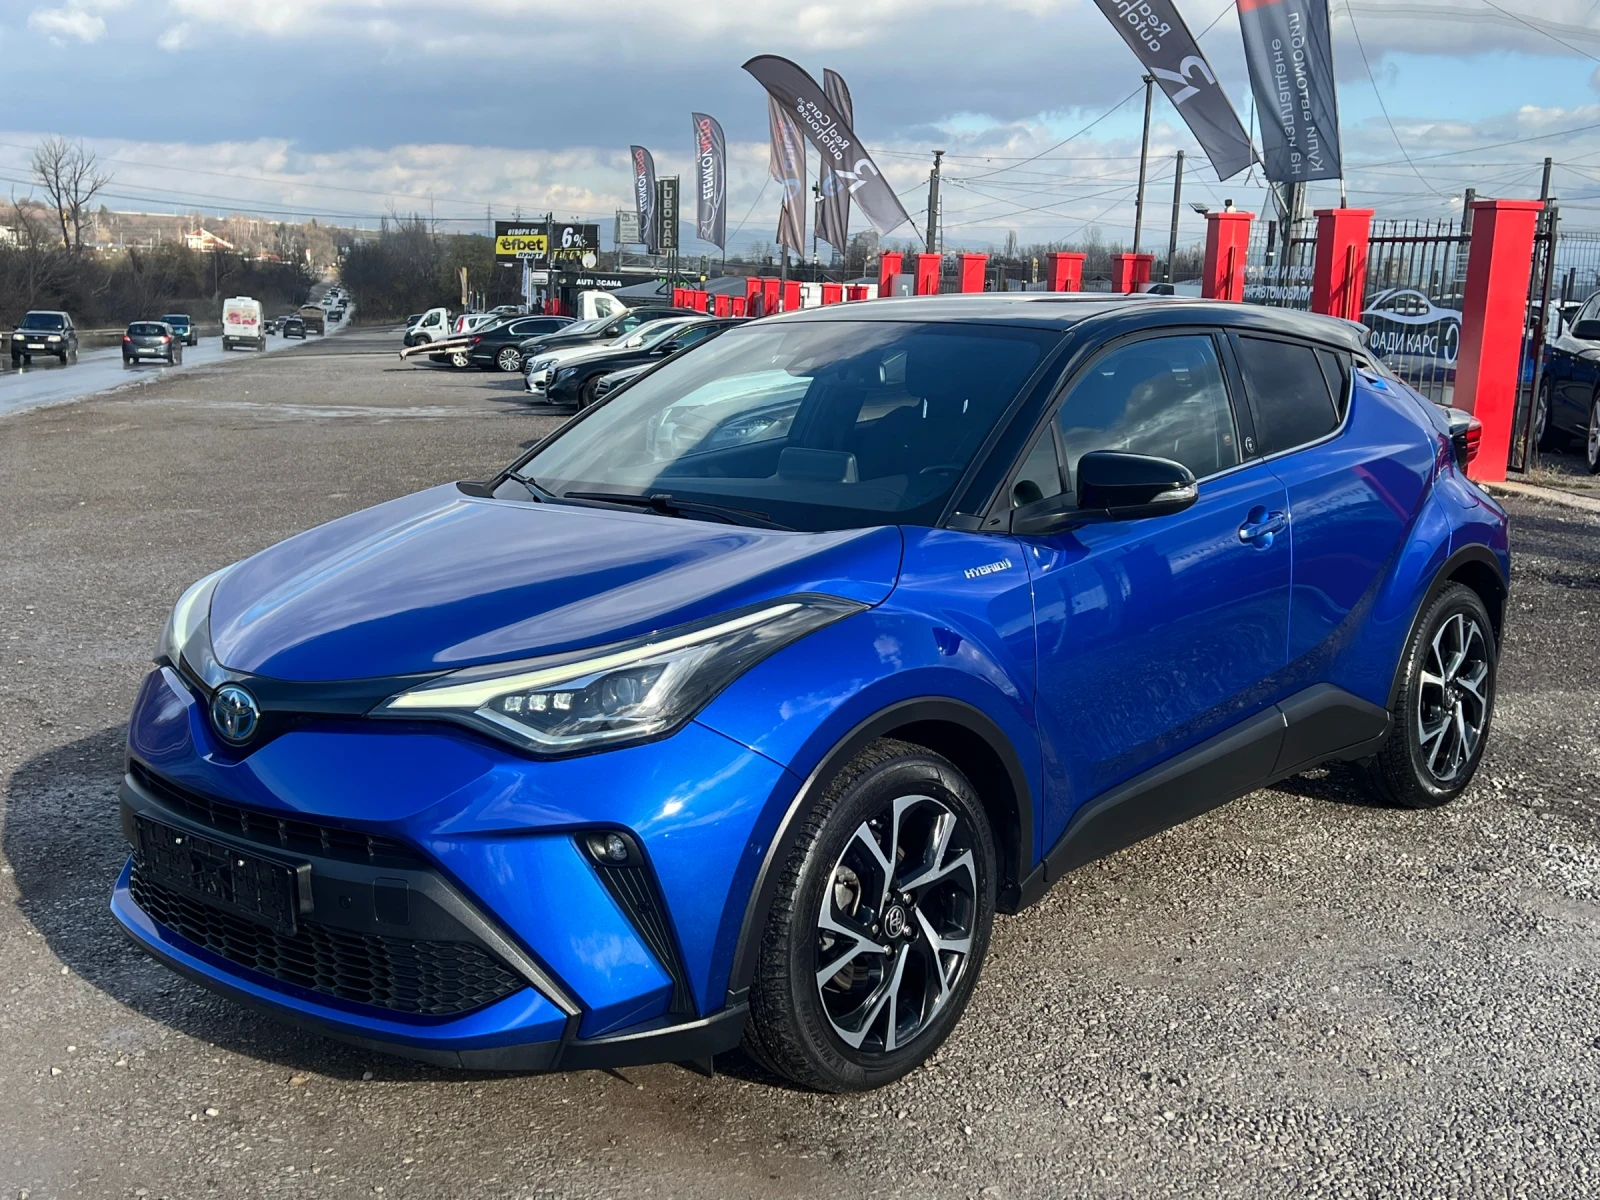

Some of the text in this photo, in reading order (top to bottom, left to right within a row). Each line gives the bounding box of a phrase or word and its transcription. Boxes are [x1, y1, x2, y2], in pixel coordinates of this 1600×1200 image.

[663, 181, 673, 247] LUBO CAR
[501, 237, 544, 251] efbet
[1370, 330, 1438, 355] ФАДИ КАРС
[964, 560, 1008, 579] HYBRID
